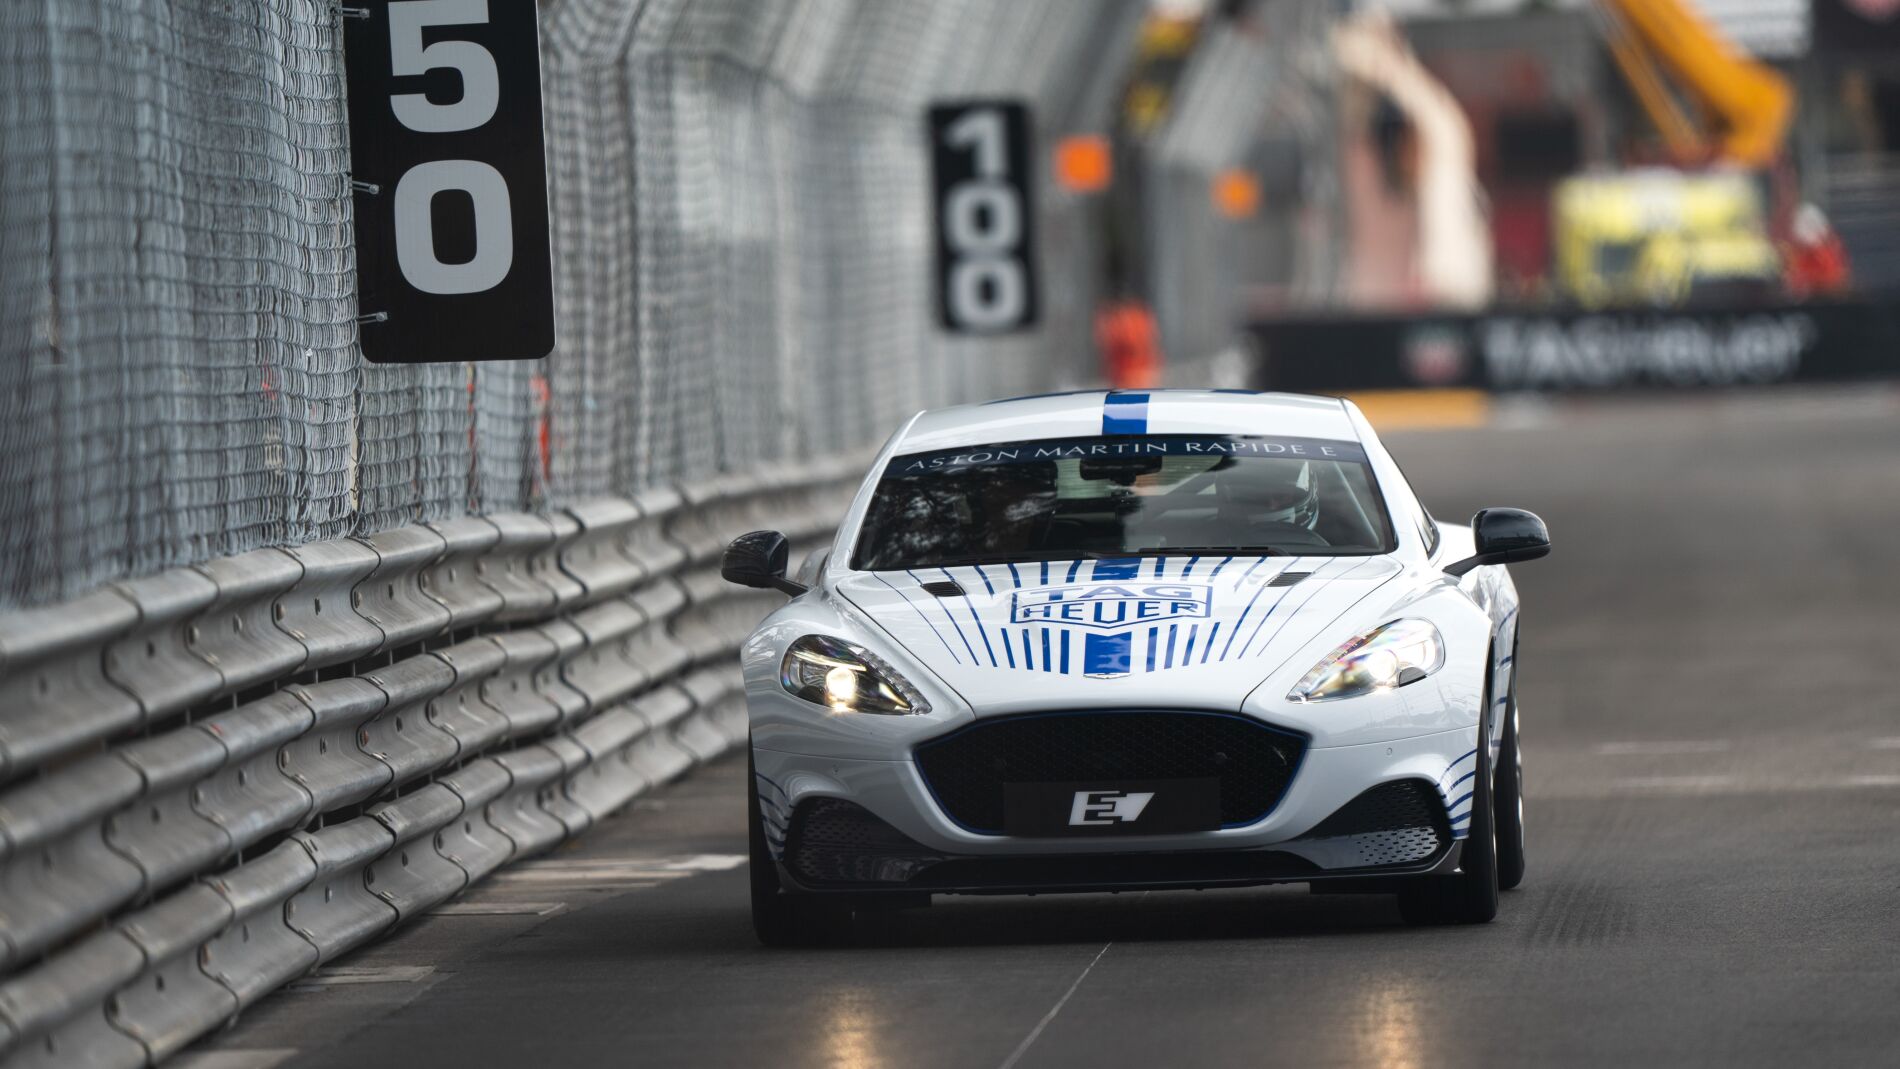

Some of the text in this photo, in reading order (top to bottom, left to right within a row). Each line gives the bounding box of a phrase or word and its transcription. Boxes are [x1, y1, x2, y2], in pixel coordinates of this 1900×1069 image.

[388, 0, 513, 294] 50
[941, 109, 1027, 329] 100
[906, 442, 1337, 471] ASTON MARTIN RAPIDE E
[1030, 586, 1193, 600] TAG
[1023, 601, 1199, 624] HEUER
